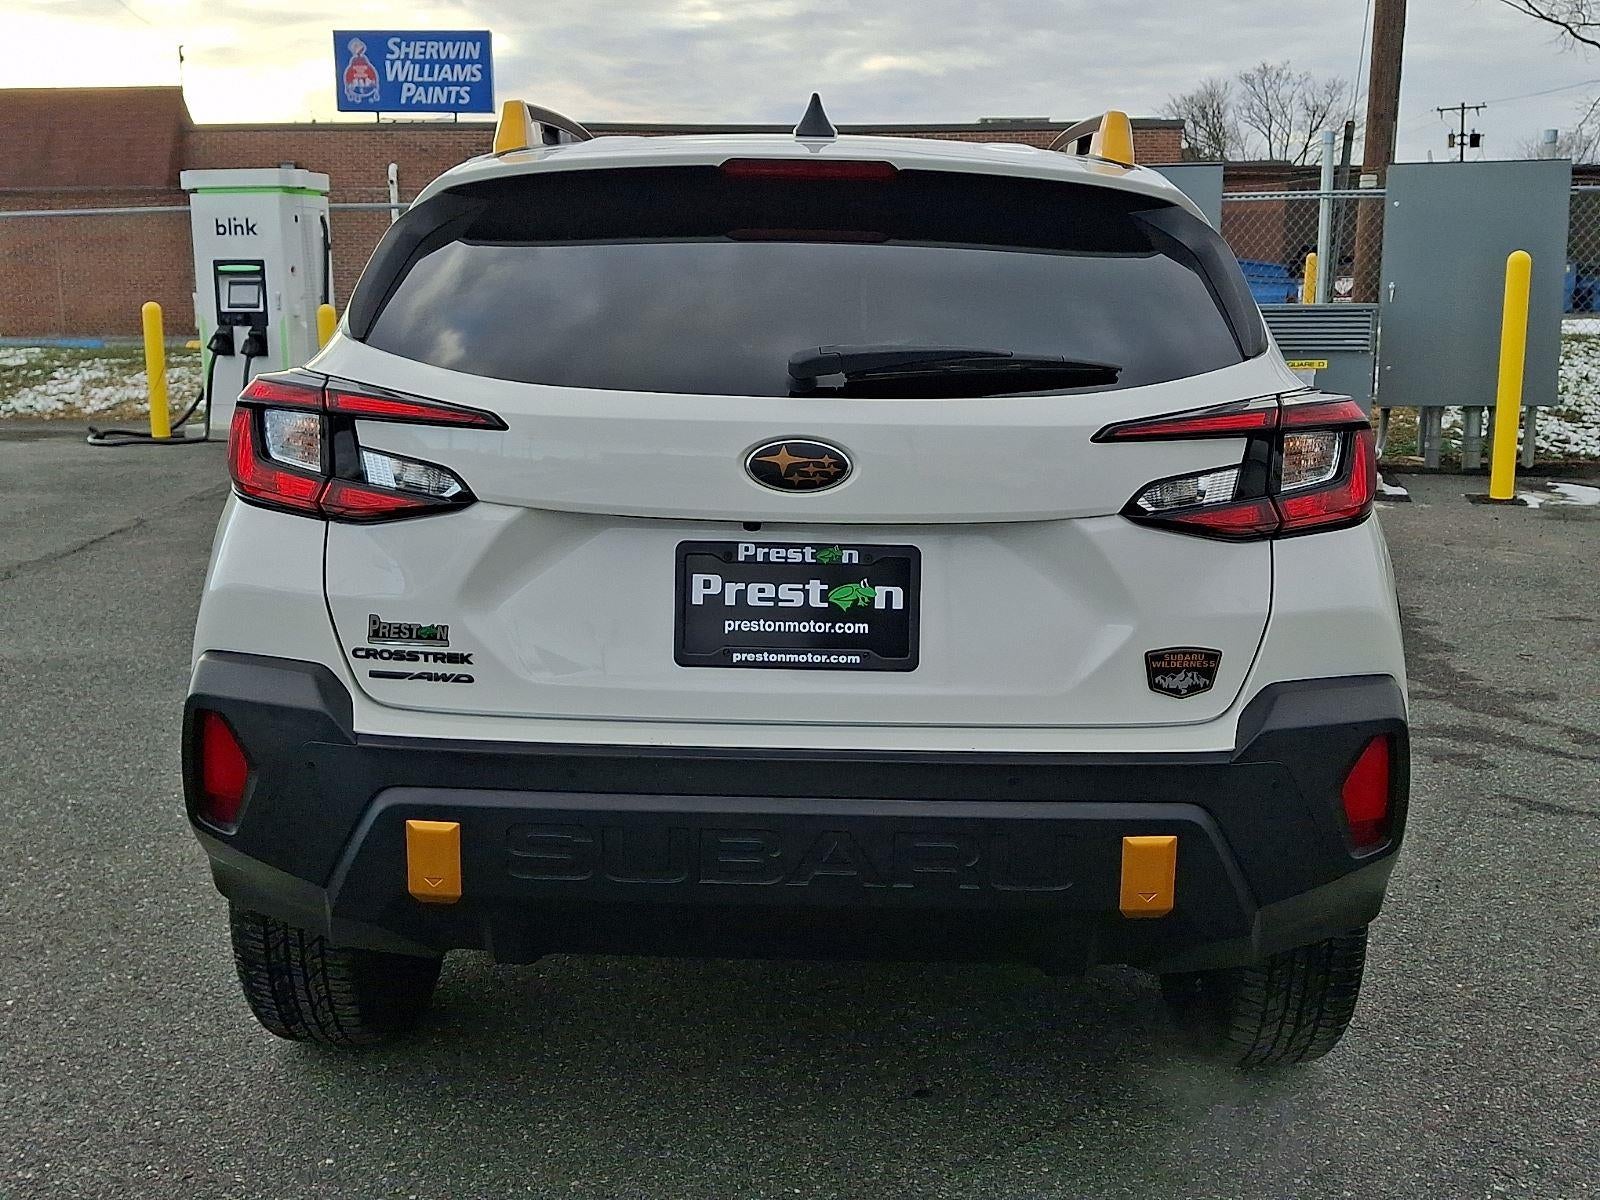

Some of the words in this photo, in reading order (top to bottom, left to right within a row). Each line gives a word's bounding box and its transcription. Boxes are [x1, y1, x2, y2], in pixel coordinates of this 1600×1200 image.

[386, 37, 481, 60] SHERWIN
[384, 60, 482, 82] WILLIAMS
[400, 82, 471, 104] PAINTS
[215, 217, 258, 236] blink
[724, 618, 869, 634] prestonmotor.com
[352, 647, 474, 665] CROSSTREK
[732, 651, 861, 664] prestonmotor.com
[408, 671, 474, 683] AWD
[505, 821, 1079, 893] SUBARU
